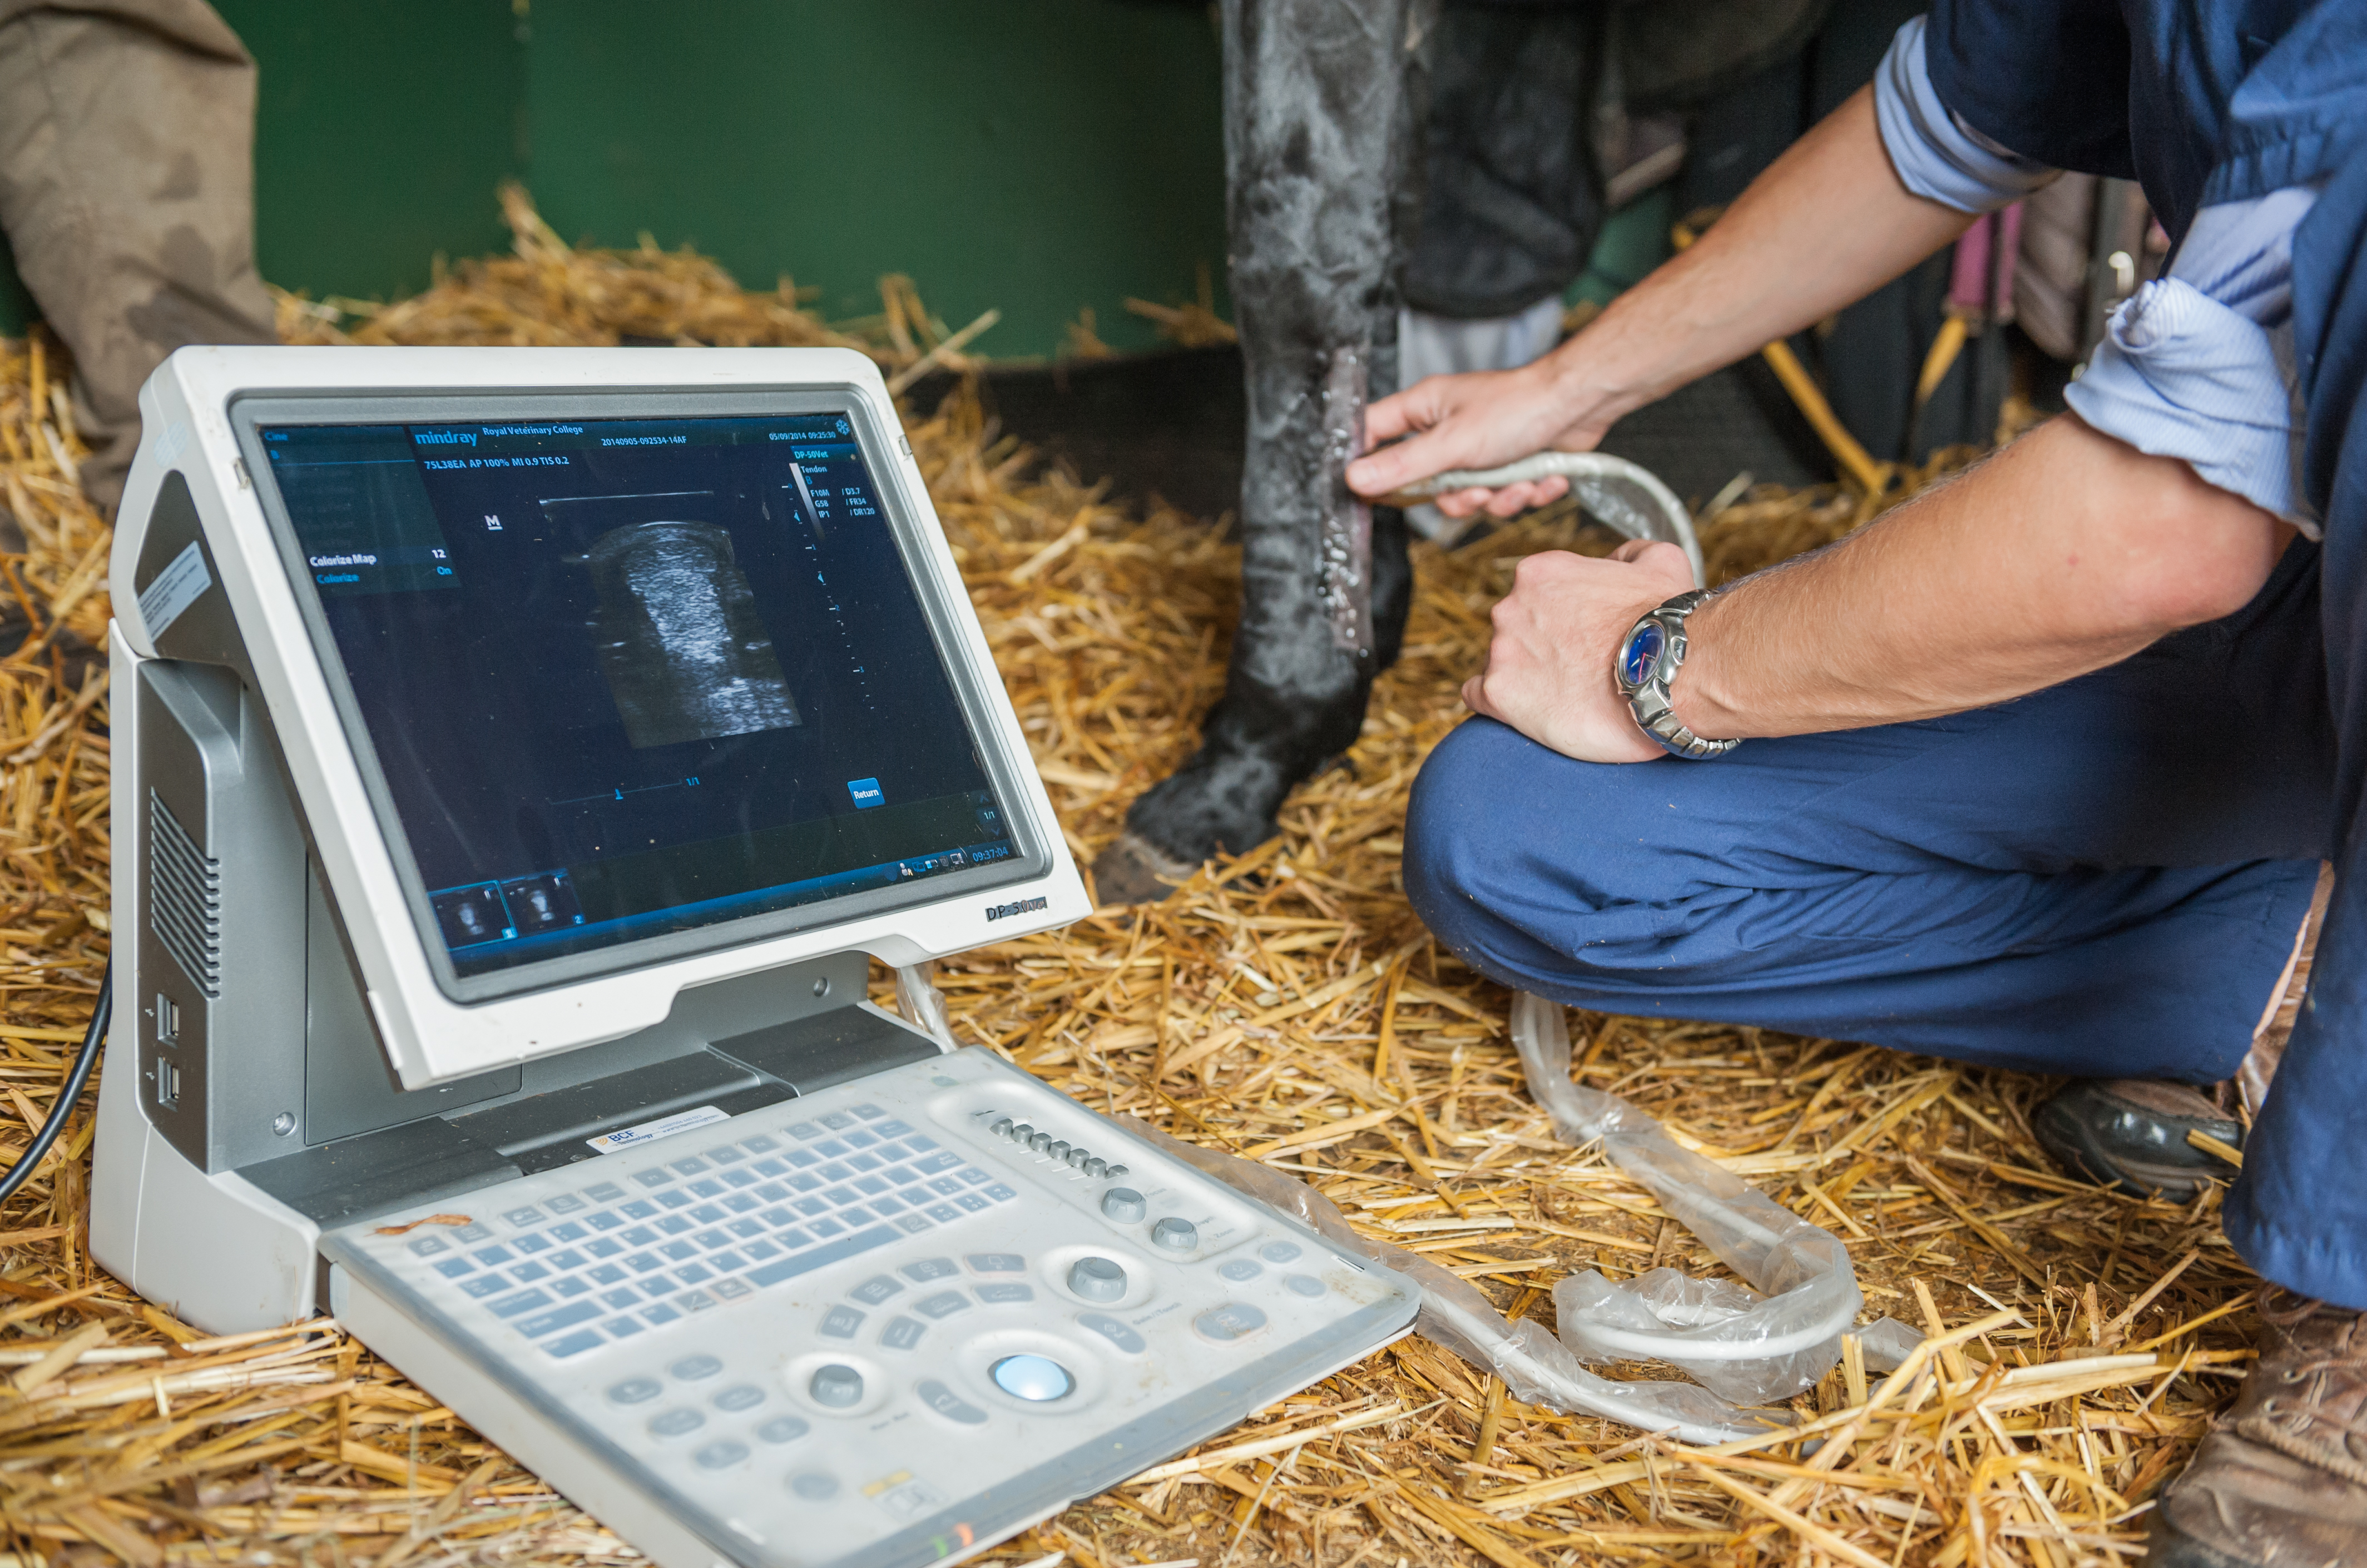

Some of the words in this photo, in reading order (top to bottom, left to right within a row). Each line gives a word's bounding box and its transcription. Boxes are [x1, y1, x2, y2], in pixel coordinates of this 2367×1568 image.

[482, 427, 507, 437] Royal
[509, 426, 552, 436] Veterinary
[553, 425, 584, 435] College
[415, 431, 477, 447] mindray
[601, 435, 687, 446] 20140905-092534-14AF
[794, 451, 829, 459] DP-50Vet
[424, 460, 467, 470] 75L38EA
[469, 459, 482, 468] AP
[483, 458, 510, 468] 100%
[512, 458, 524, 467] MI
[526, 457, 539, 465] 0.9
[539, 456, 554, 465] TIS
[555, 456, 570, 465] 0.2
[810, 489, 830, 498] F10M
[485, 515, 502, 528] M
[310, 555, 353, 567] Colorize
[352, 554, 377, 565] Map
[432, 549, 447, 559] 12
[316, 573, 360, 584] Colorize
[437, 566, 453, 575] On
[853, 788, 880, 800] Return
[984, 811, 996, 820] 1/1
[973, 846, 1009, 862] 09:37:04
[575, 915, 583, 924] 2
[607, 1129, 635, 1142] BCF
[616, 1133, 653, 1145] Technology
[1144, 1188, 1167, 1198] Focus
[1194, 1215, 1216, 1227] Depth
[1214, 1228, 1236, 1238] Zoom
